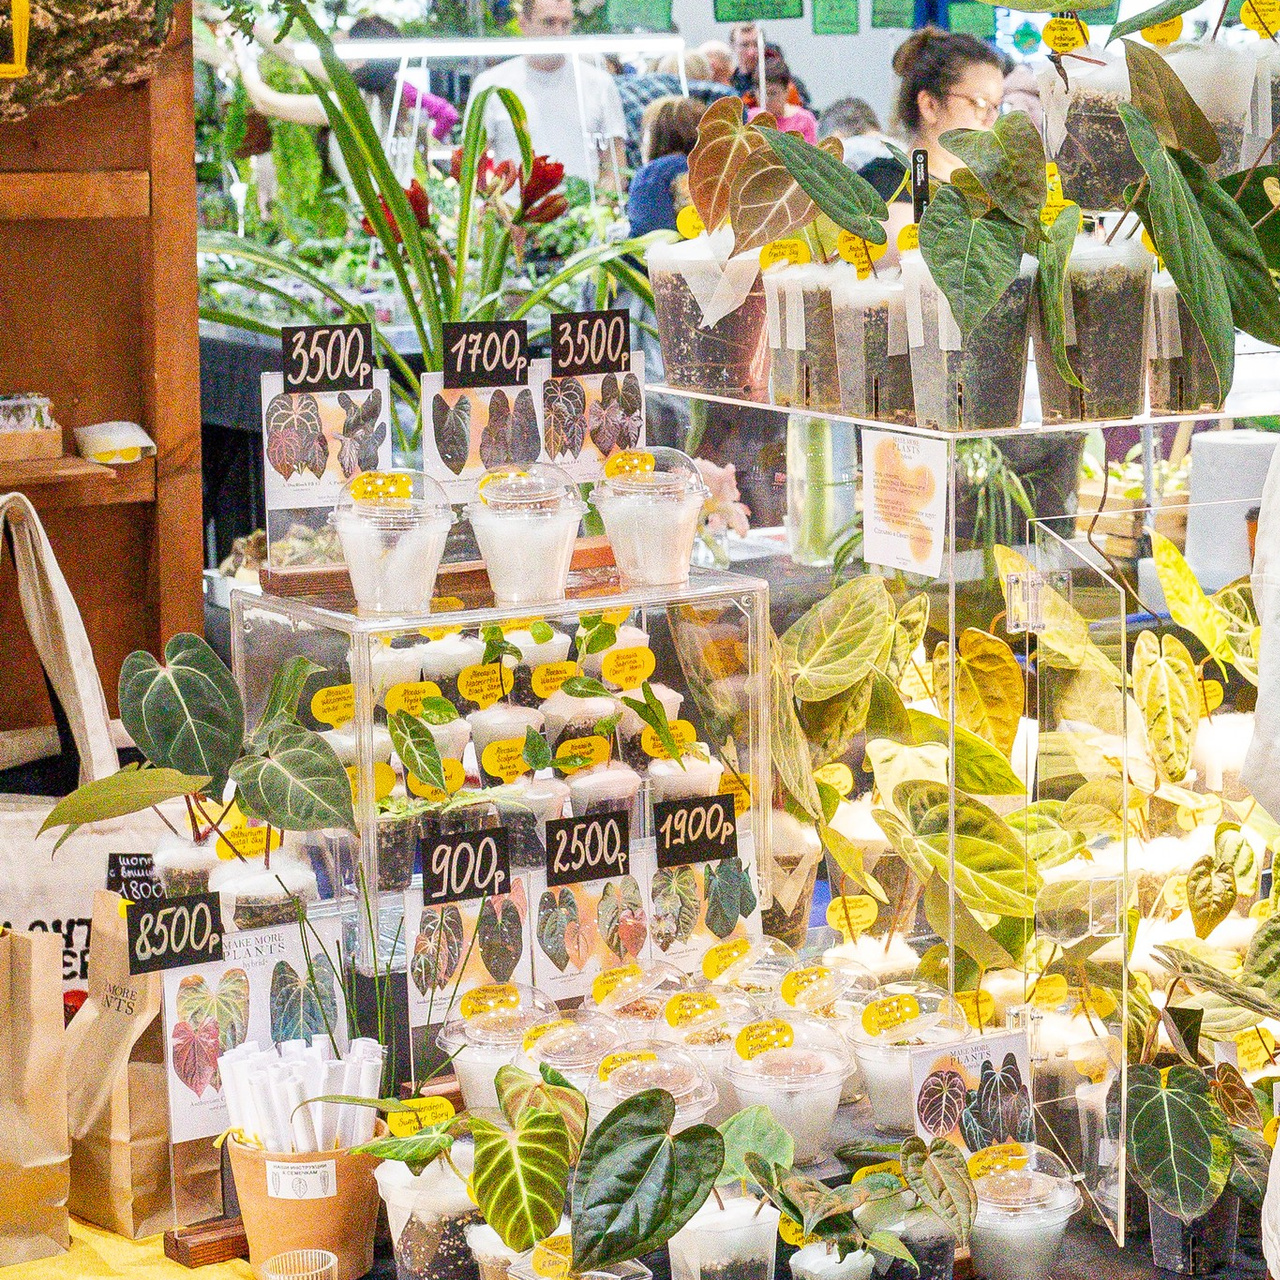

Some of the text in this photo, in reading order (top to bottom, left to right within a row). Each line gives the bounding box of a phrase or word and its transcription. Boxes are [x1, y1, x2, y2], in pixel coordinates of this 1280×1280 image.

[254, 932, 285, 946] MORE
[222, 942, 286, 962] PLANTS
[949, 1050, 992, 1066] PLANTS
